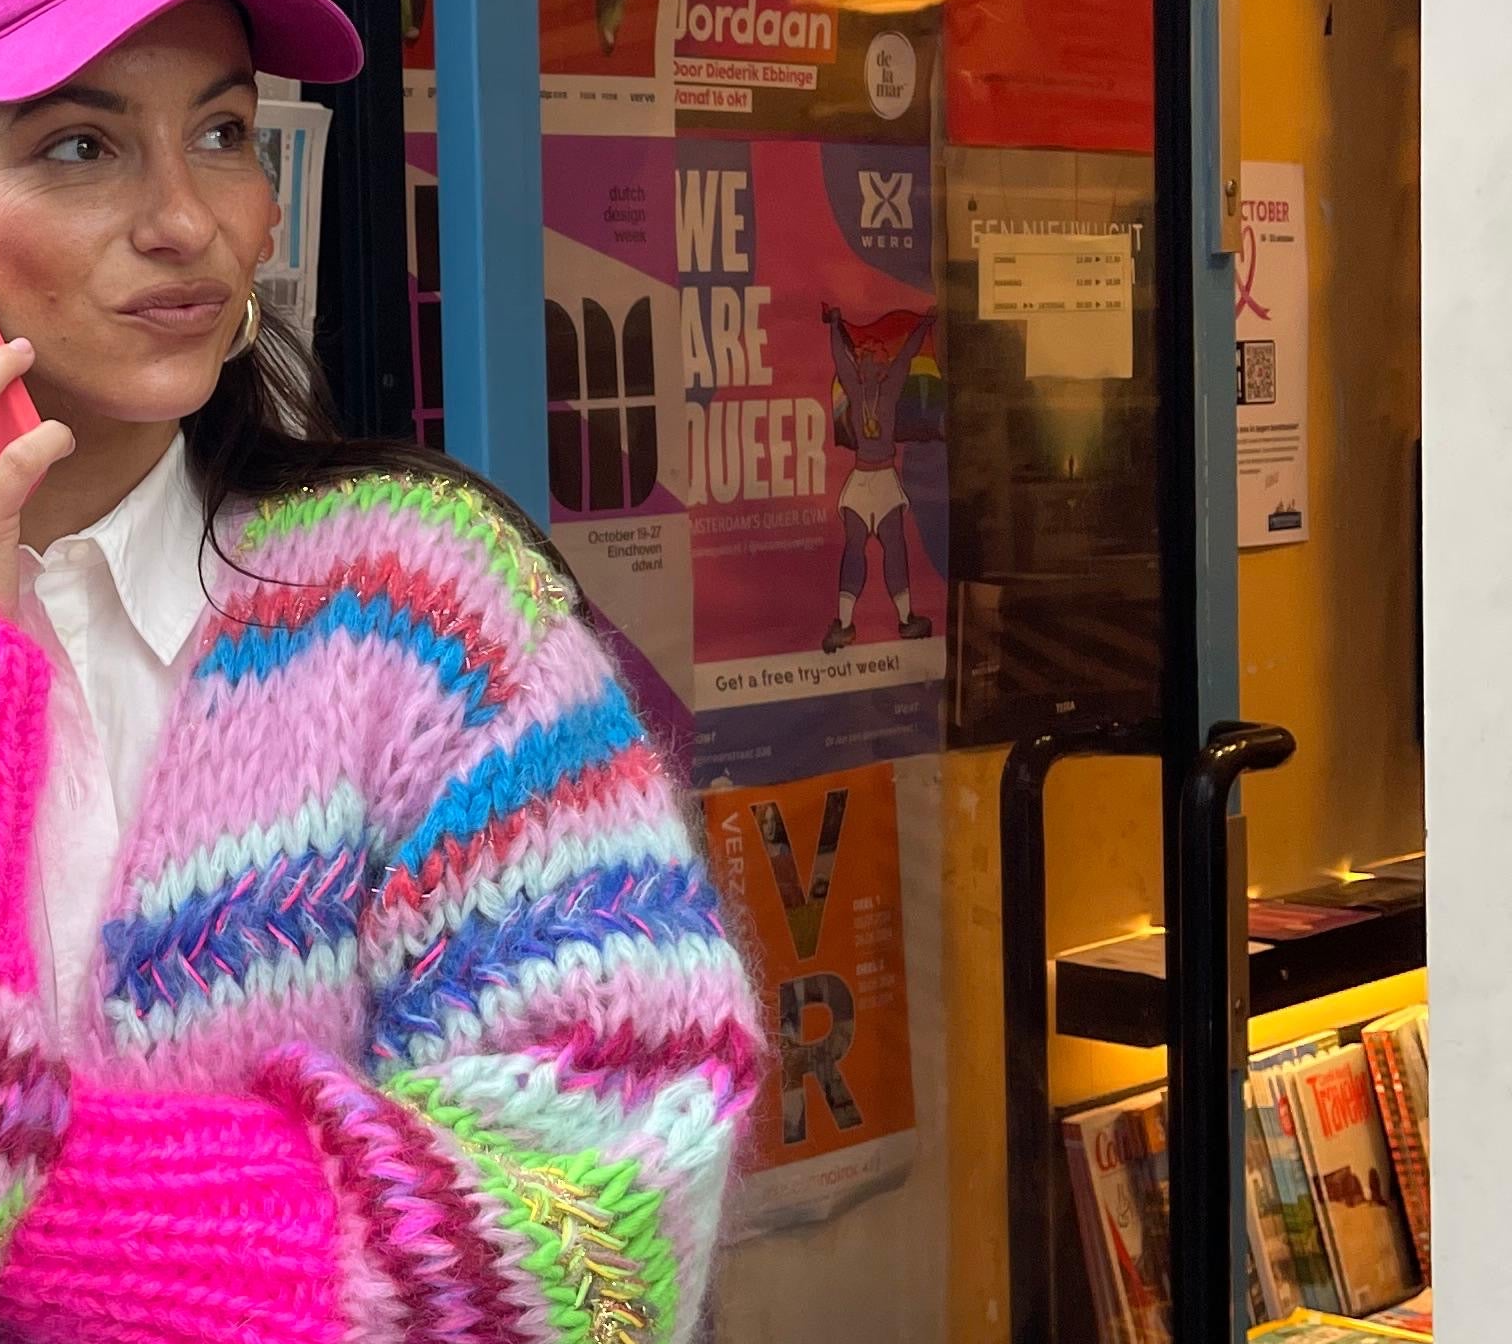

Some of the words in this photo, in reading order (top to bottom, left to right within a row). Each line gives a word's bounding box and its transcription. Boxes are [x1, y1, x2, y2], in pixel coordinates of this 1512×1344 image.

[876, 49, 892, 68] de
[706, 62, 760, 81] Diederik
[762, 66, 814, 87] Ebbinge
[882, 68, 893, 84] la
[712, 91, 724, 106] 16
[727, 92, 748, 107] okt
[876, 83, 905, 98] mar
[609, 186, 646, 202] dutch
[603, 206, 646, 224] design
[675, 169, 749, 273] WE
[615, 229, 647, 243] week
[861, 235, 913, 250] WERQ
[680, 286, 774, 389] ARE
[686, 397, 828, 507] QUEER
[763, 510, 802, 529] QUEER
[802, 508, 828, 524] GYM
[588, 528, 635, 544] October
[607, 543, 663, 559] Eindhoven
[715, 674, 743, 693] Get
[748, 675, 758, 689] a
[762, 669, 794, 688] free
[798, 662, 853, 685] try-out
[856, 655, 901, 676] week!
